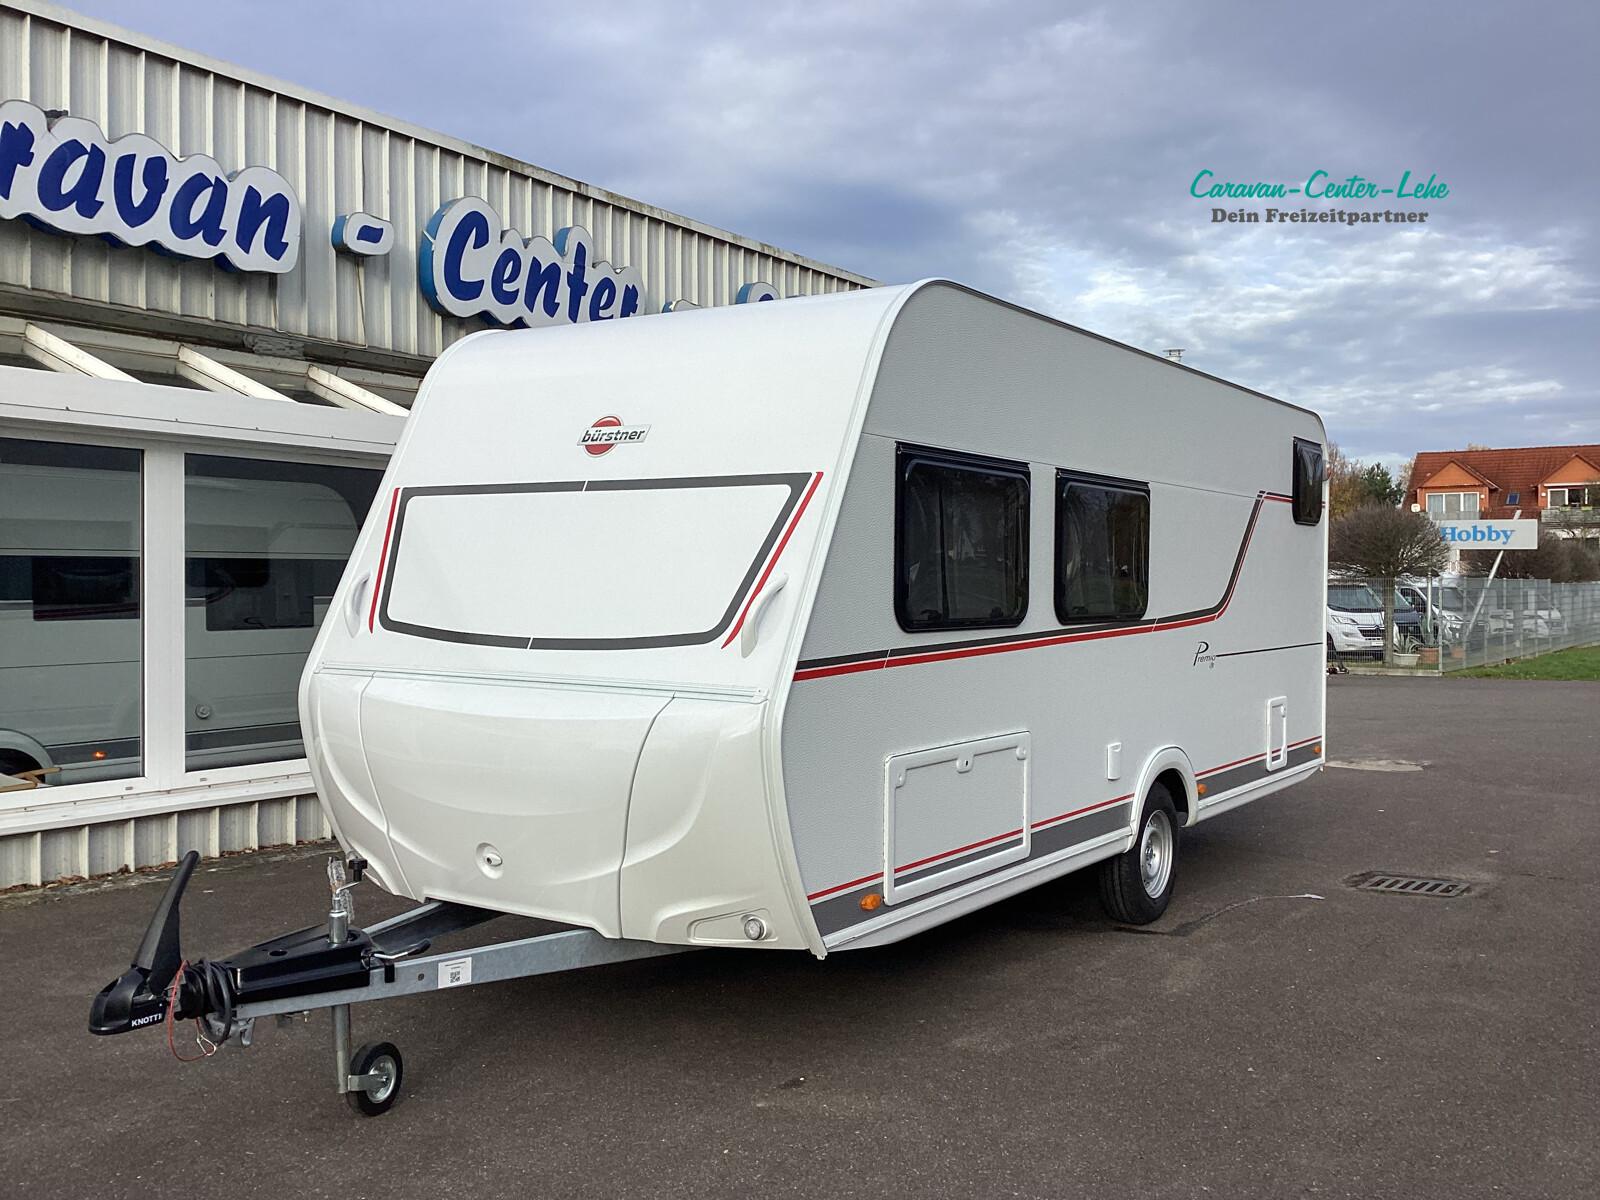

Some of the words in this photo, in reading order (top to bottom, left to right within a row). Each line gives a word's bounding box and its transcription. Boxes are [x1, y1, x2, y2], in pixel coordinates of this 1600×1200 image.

[443, 209, 640, 324] Center
[581, 429, 646, 443] bürstner
[1440, 525, 1516, 545] Hobby
[1193, 641, 1216, 666] Premio
